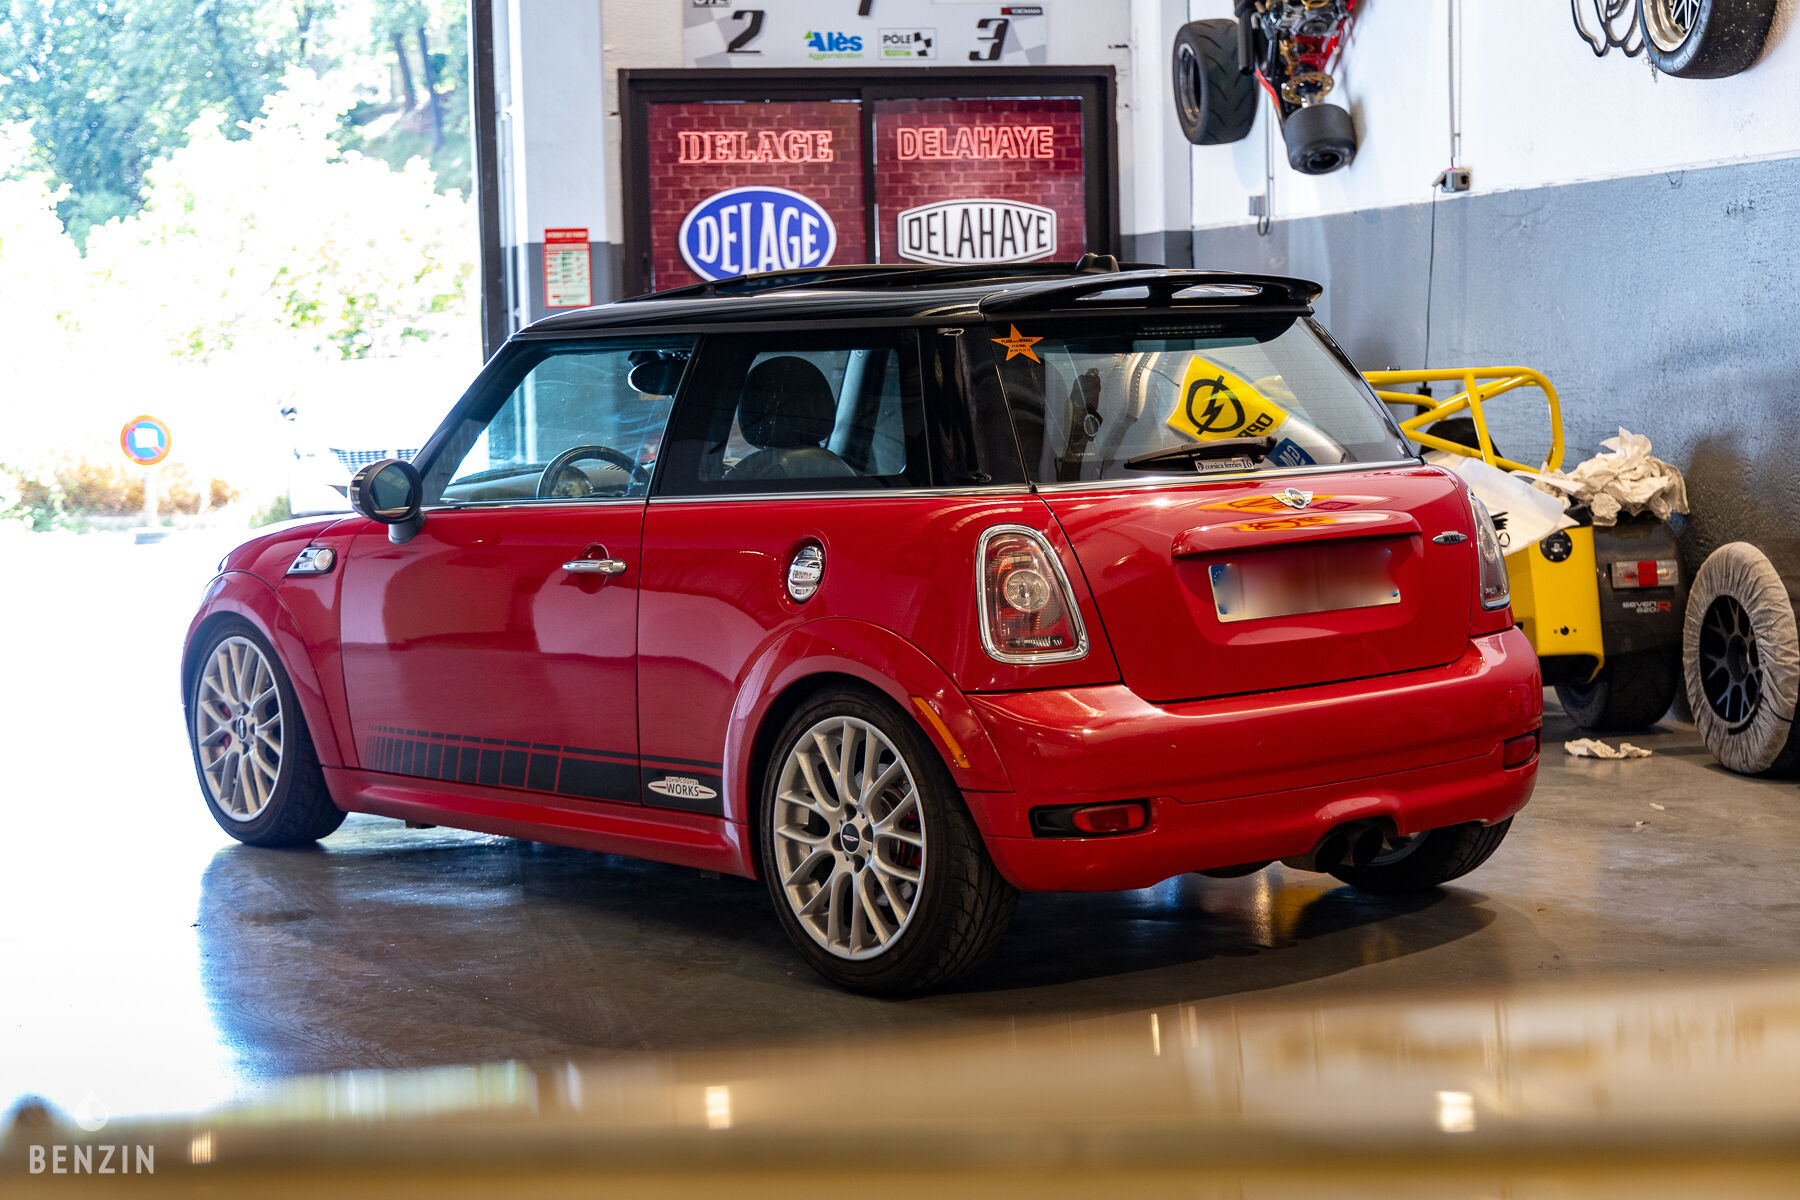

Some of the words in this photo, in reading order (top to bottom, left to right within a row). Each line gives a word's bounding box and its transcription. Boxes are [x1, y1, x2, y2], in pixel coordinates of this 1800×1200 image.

[726, 10, 764, 53] 2
[805, 31, 863, 52] Alès
[882, 31, 911, 44] PÔLE
[969, 18, 1009, 61] 3
[678, 130, 834, 163] DELAGE
[896, 126, 1055, 160] DELAHAYE
[697, 201, 820, 274] DELAGE
[908, 207, 1048, 259] DELAHAYE
[1205, 462, 1224, 470] corsica
[1224, 461, 1242, 469] ferries
[1241, 458, 1253, 469] 16
[666, 784, 699, 796] WORKS
